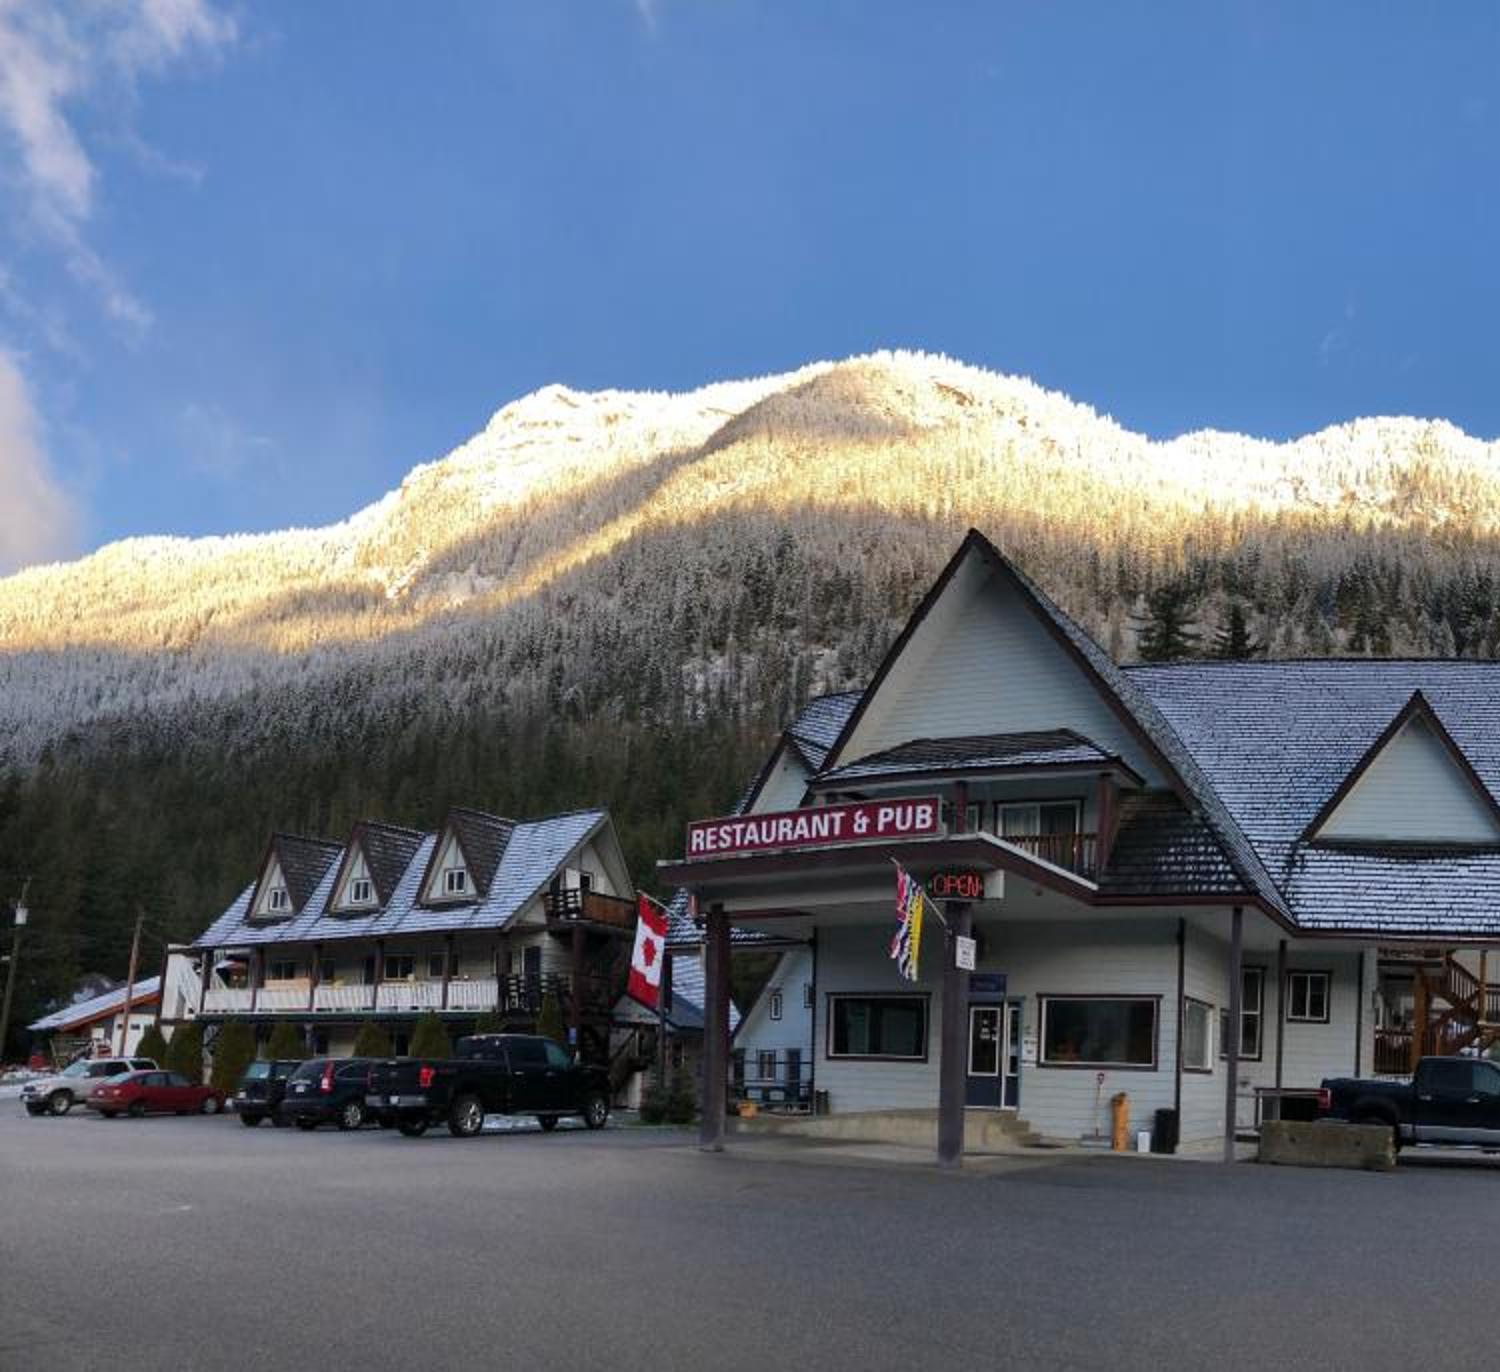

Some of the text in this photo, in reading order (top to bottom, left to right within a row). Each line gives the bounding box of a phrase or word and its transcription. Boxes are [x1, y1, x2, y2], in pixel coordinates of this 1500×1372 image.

[691, 805, 933, 851] RESTAURANT & PUB
[933, 874, 979, 897] OPEN
